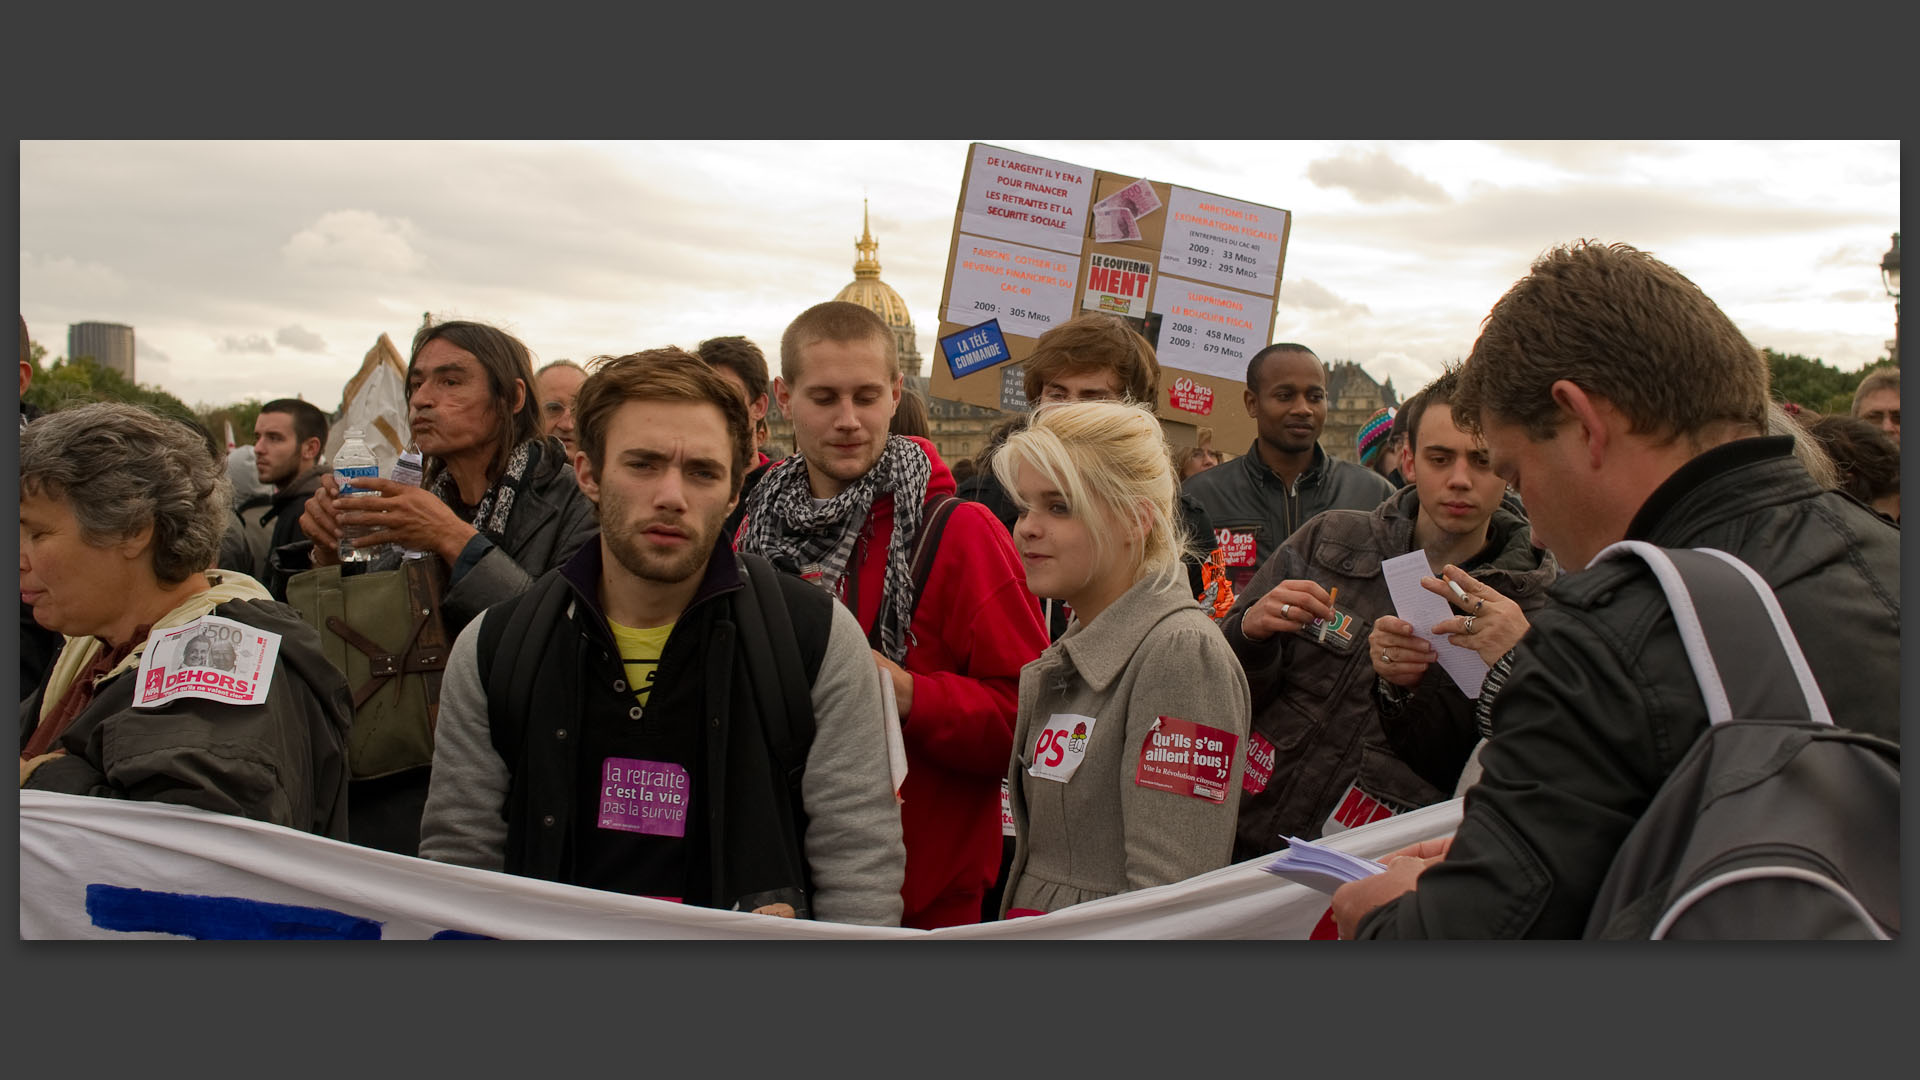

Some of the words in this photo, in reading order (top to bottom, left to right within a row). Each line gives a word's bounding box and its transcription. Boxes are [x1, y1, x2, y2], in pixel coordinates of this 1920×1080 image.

[987, 157, 999, 167] DE
[1001, 160, 1043, 176] L'ARGENT
[1045, 170, 1053, 178] IL
[1055, 171, 1061, 179] Y
[1062, 173, 1075, 182] EN
[1075, 176, 1082, 184] A
[997, 176, 1023, 188] POUR
[1024, 181, 1068, 198] FINANCER
[986, 190, 1001, 201] LES
[1002, 194, 1048, 210] RETRAITES
[1050, 203, 1061, 213] ET
[1063, 206, 1073, 216] LA
[987, 206, 1028, 221] SECURITE
[1030, 215, 1067, 229] SOCIALE
[1245, 212, 1259, 223] LES
[1241, 226, 1279, 242] FISCALES
[1189, 243, 1210, 254] 2009
[1222, 250, 1233, 260] 33
[1239, 241, 1250, 249] CAC
[972, 248, 1011, 261] FAISONS
[1015, 255, 1050, 269] COTISER
[1053, 264, 1067, 273] LES
[1092, 254, 1102, 266] LE
[1187, 257, 1208, 268] 1992
[1218, 263, 1234, 274] 295
[962, 261, 1004, 276] REVENUS
[1006, 269, 1057, 286] FINANCIERS
[1059, 279, 1073, 289] DU
[1088, 266, 1149, 298] MENT
[1001, 283, 1017, 294] CAC
[1020, 288, 1032, 296] 40
[974, 301, 996, 312] 2009
[1010, 307, 1026, 318] 305
[1187, 292, 1243, 312] SUPPRIMONS
[1171, 304, 1181, 315] LE
[1183, 308, 1225, 323] BOUCLIER
[1226, 317, 1254, 330] FISCAL
[957, 340, 970, 353] LA
[968, 329, 990, 349] TÉLÉ
[1172, 322, 1193, 334] 2008
[1206, 330, 1222, 341] 458
[1169, 336, 1191, 348] 2009
[1203, 343, 1219, 354] 679
[954, 343, 1002, 369] COMMANDE
[1175, 377, 1193, 392] 60
[1193, 384, 1212, 395] ans
[1011, 398, 1028, 407] taux
[1233, 533, 1254, 544] ans
[208, 624, 243, 644] 500
[145, 687, 160, 698] NPA
[208, 686, 229, 697] valent
[1034, 728, 1069, 768] PS
[1152, 732, 1192, 748] Qu'ils
[1195, 737, 1224, 753] s'en
[1145, 748, 1190, 764] aillent
[1193, 751, 1222, 768] tous
[1254, 748, 1273, 771] ans
[607, 762, 621, 782] la
[627, 769, 685, 789] retraite
[1143, 764, 1155, 772] Vite
[1163, 768, 1196, 782] Révolution
[1196, 776, 1223, 791] citoyenne
[605, 784, 637, 800] c'est
[640, 787, 653, 802] la
[659, 790, 685, 806] vie,
[603, 801, 626, 815] pas
[629, 800, 639, 816] la
[642, 806, 684, 821] survie
